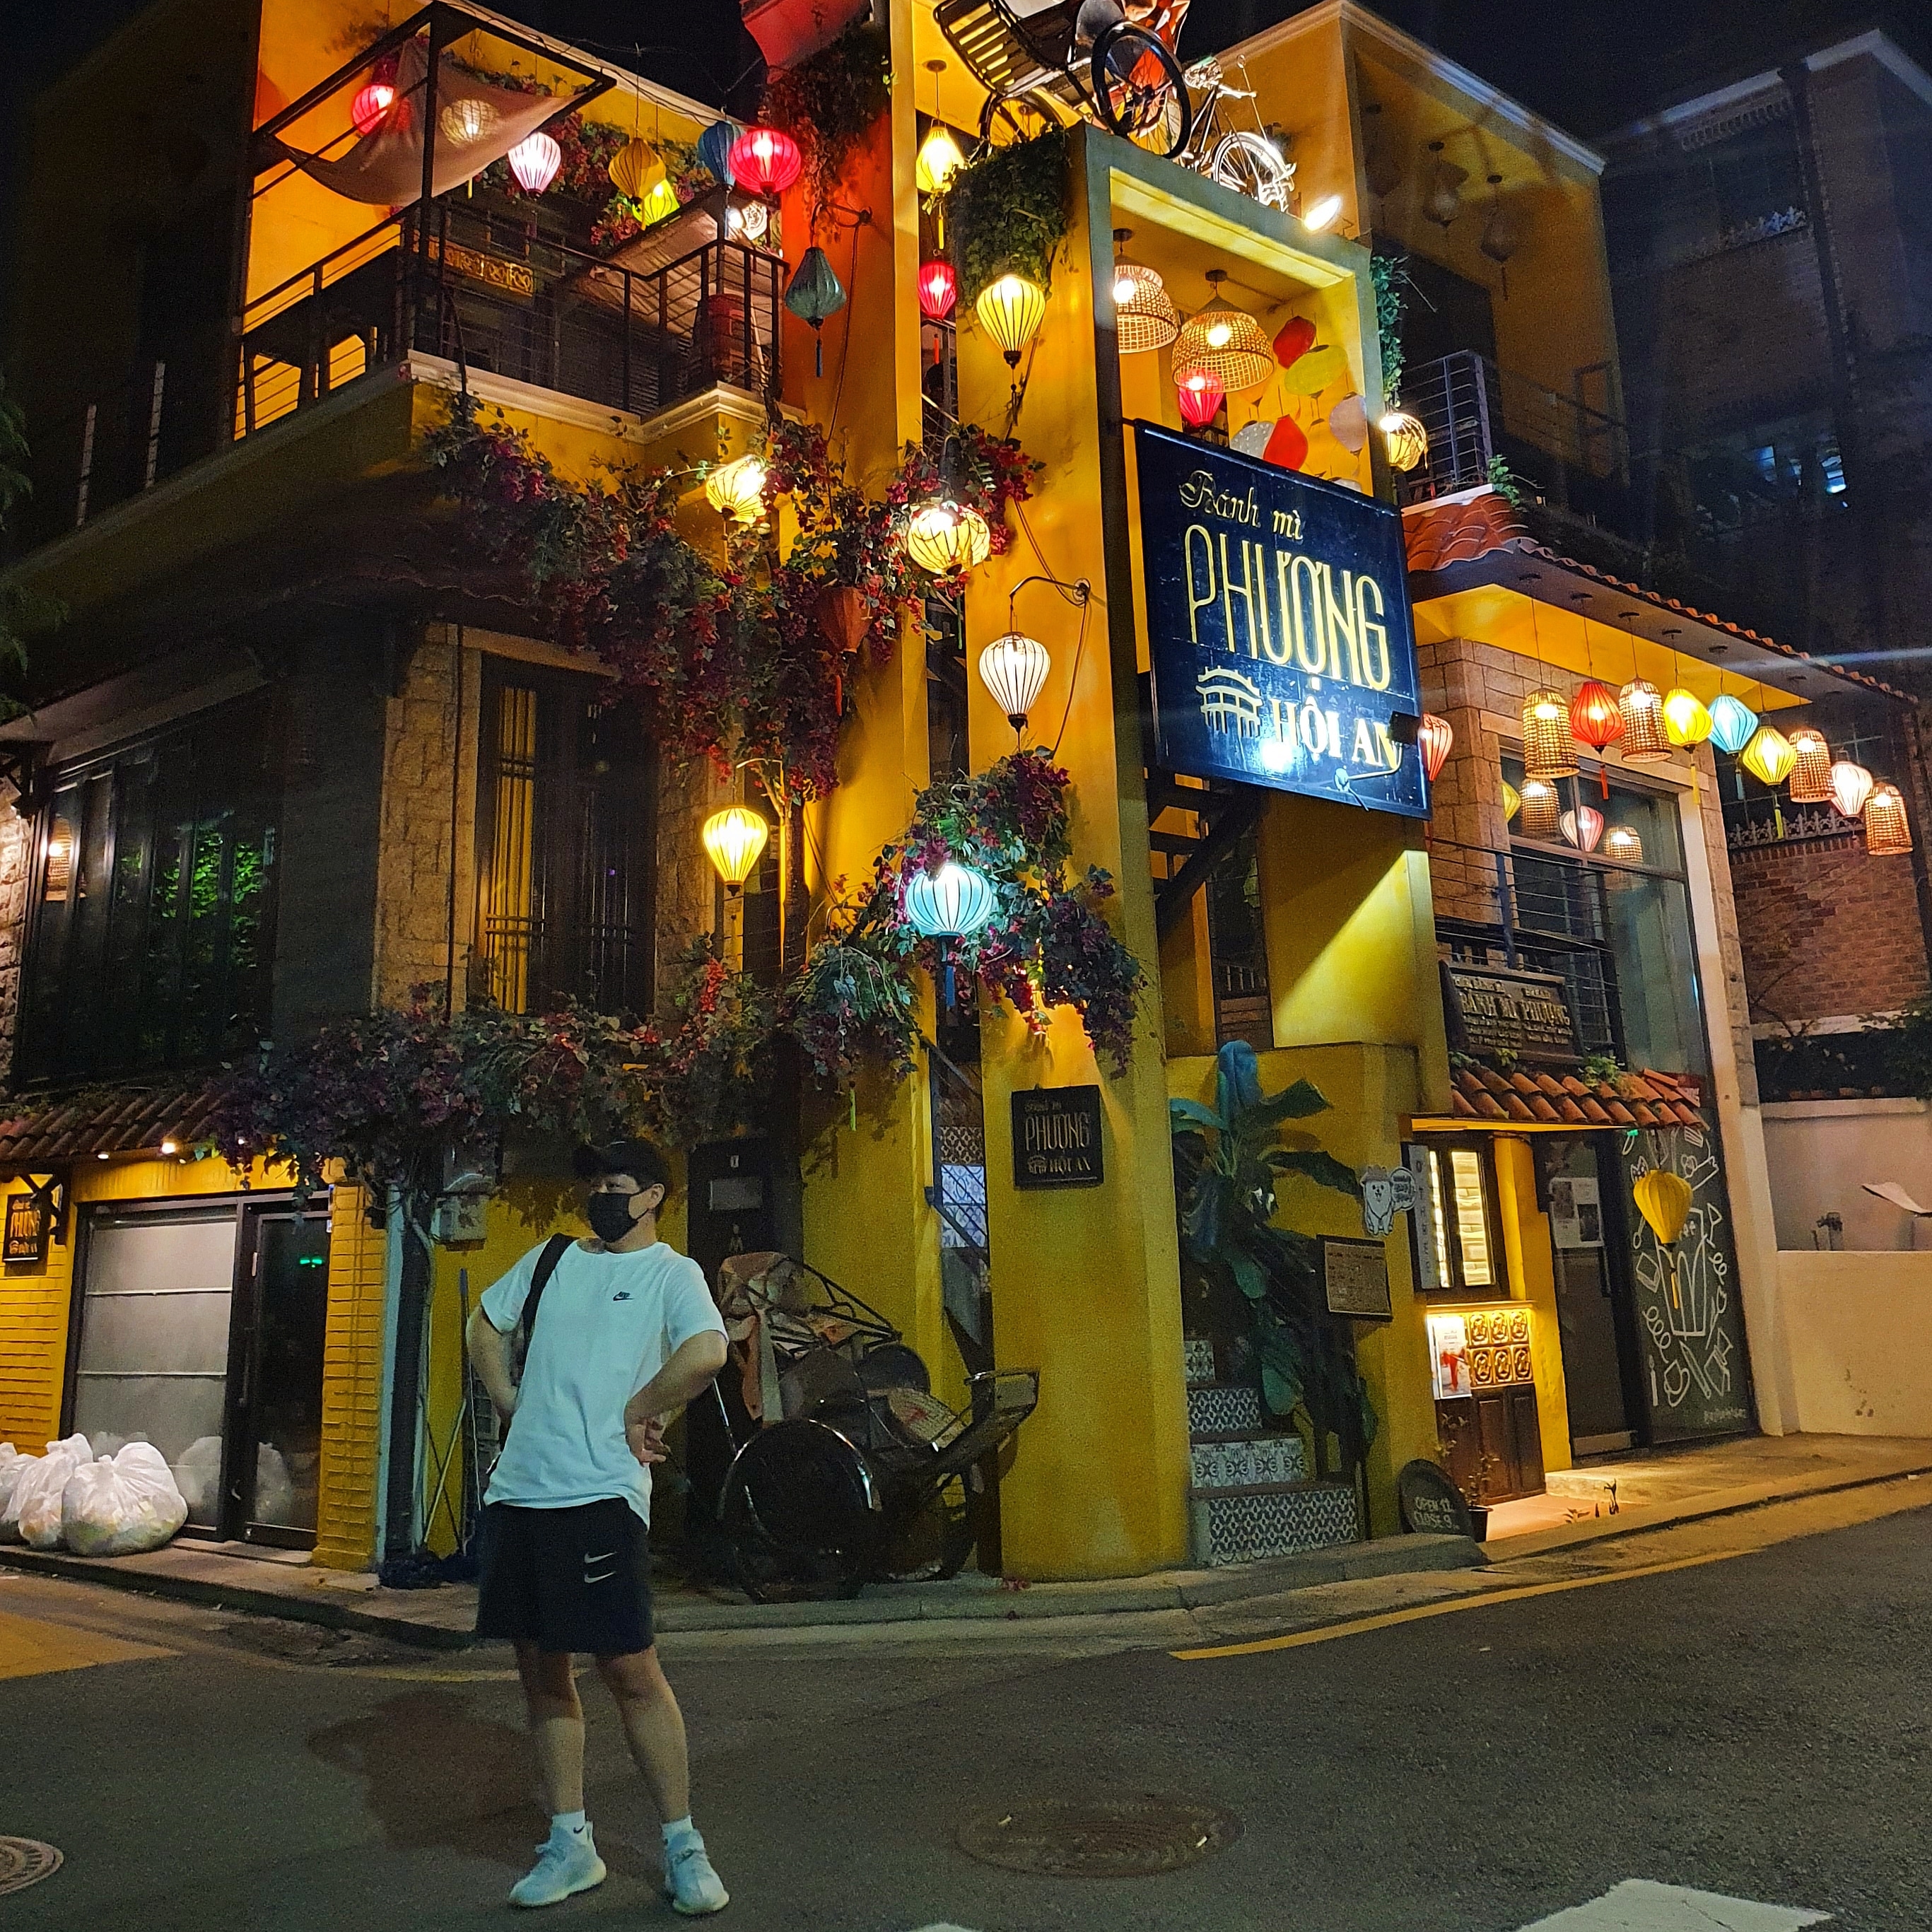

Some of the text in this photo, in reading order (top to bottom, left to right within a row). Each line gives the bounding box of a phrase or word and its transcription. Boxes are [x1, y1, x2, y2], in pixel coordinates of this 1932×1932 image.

[1272, 509, 1304, 541] mì
[1185, 525, 1392, 691] PHƯỢNG
[1351, 718, 1398, 771] AN
